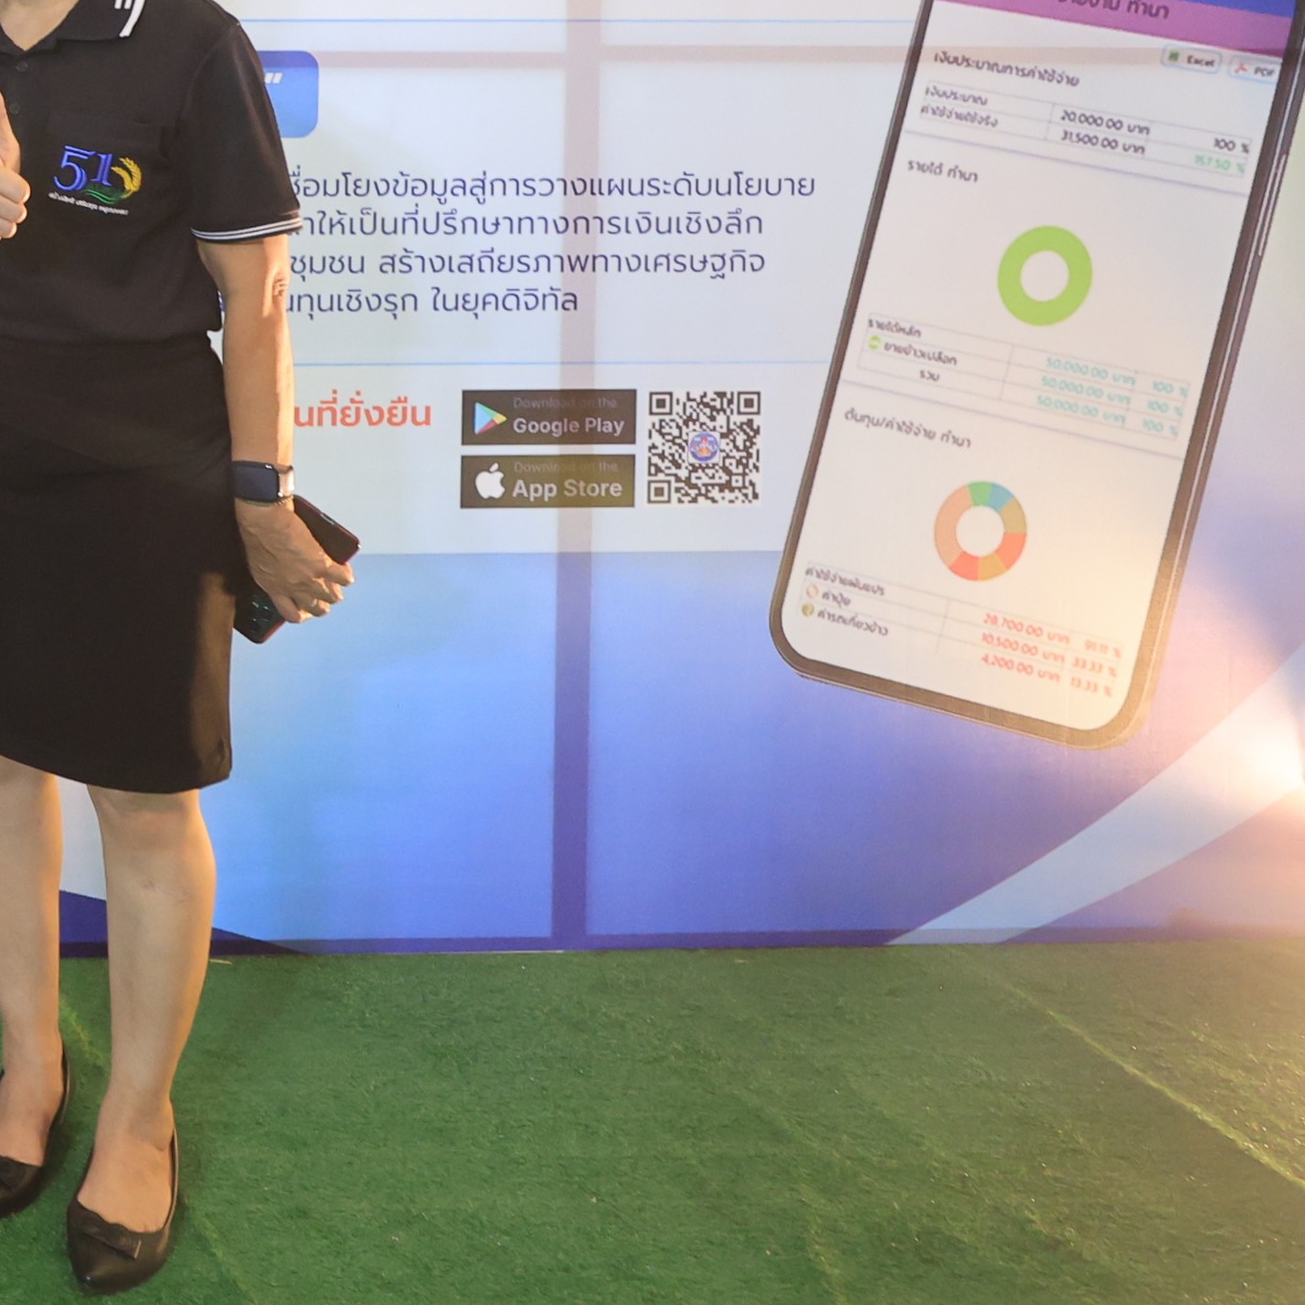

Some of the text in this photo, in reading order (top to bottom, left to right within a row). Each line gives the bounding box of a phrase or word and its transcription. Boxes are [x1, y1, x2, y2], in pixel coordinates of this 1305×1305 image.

[53, 145, 114, 191] 51
[299, 203, 763, 236] าให้เป็นที่ปรึกษาทางการเงินเชิงลึก
[378, 248, 765, 280] สร้างเสถียรภาพทางเศรษฐกิจ
[431, 286, 579, 320] ในยุคดิจิทัล
[512, 417, 625, 438] Google Play
[512, 479, 623, 502] App Store
